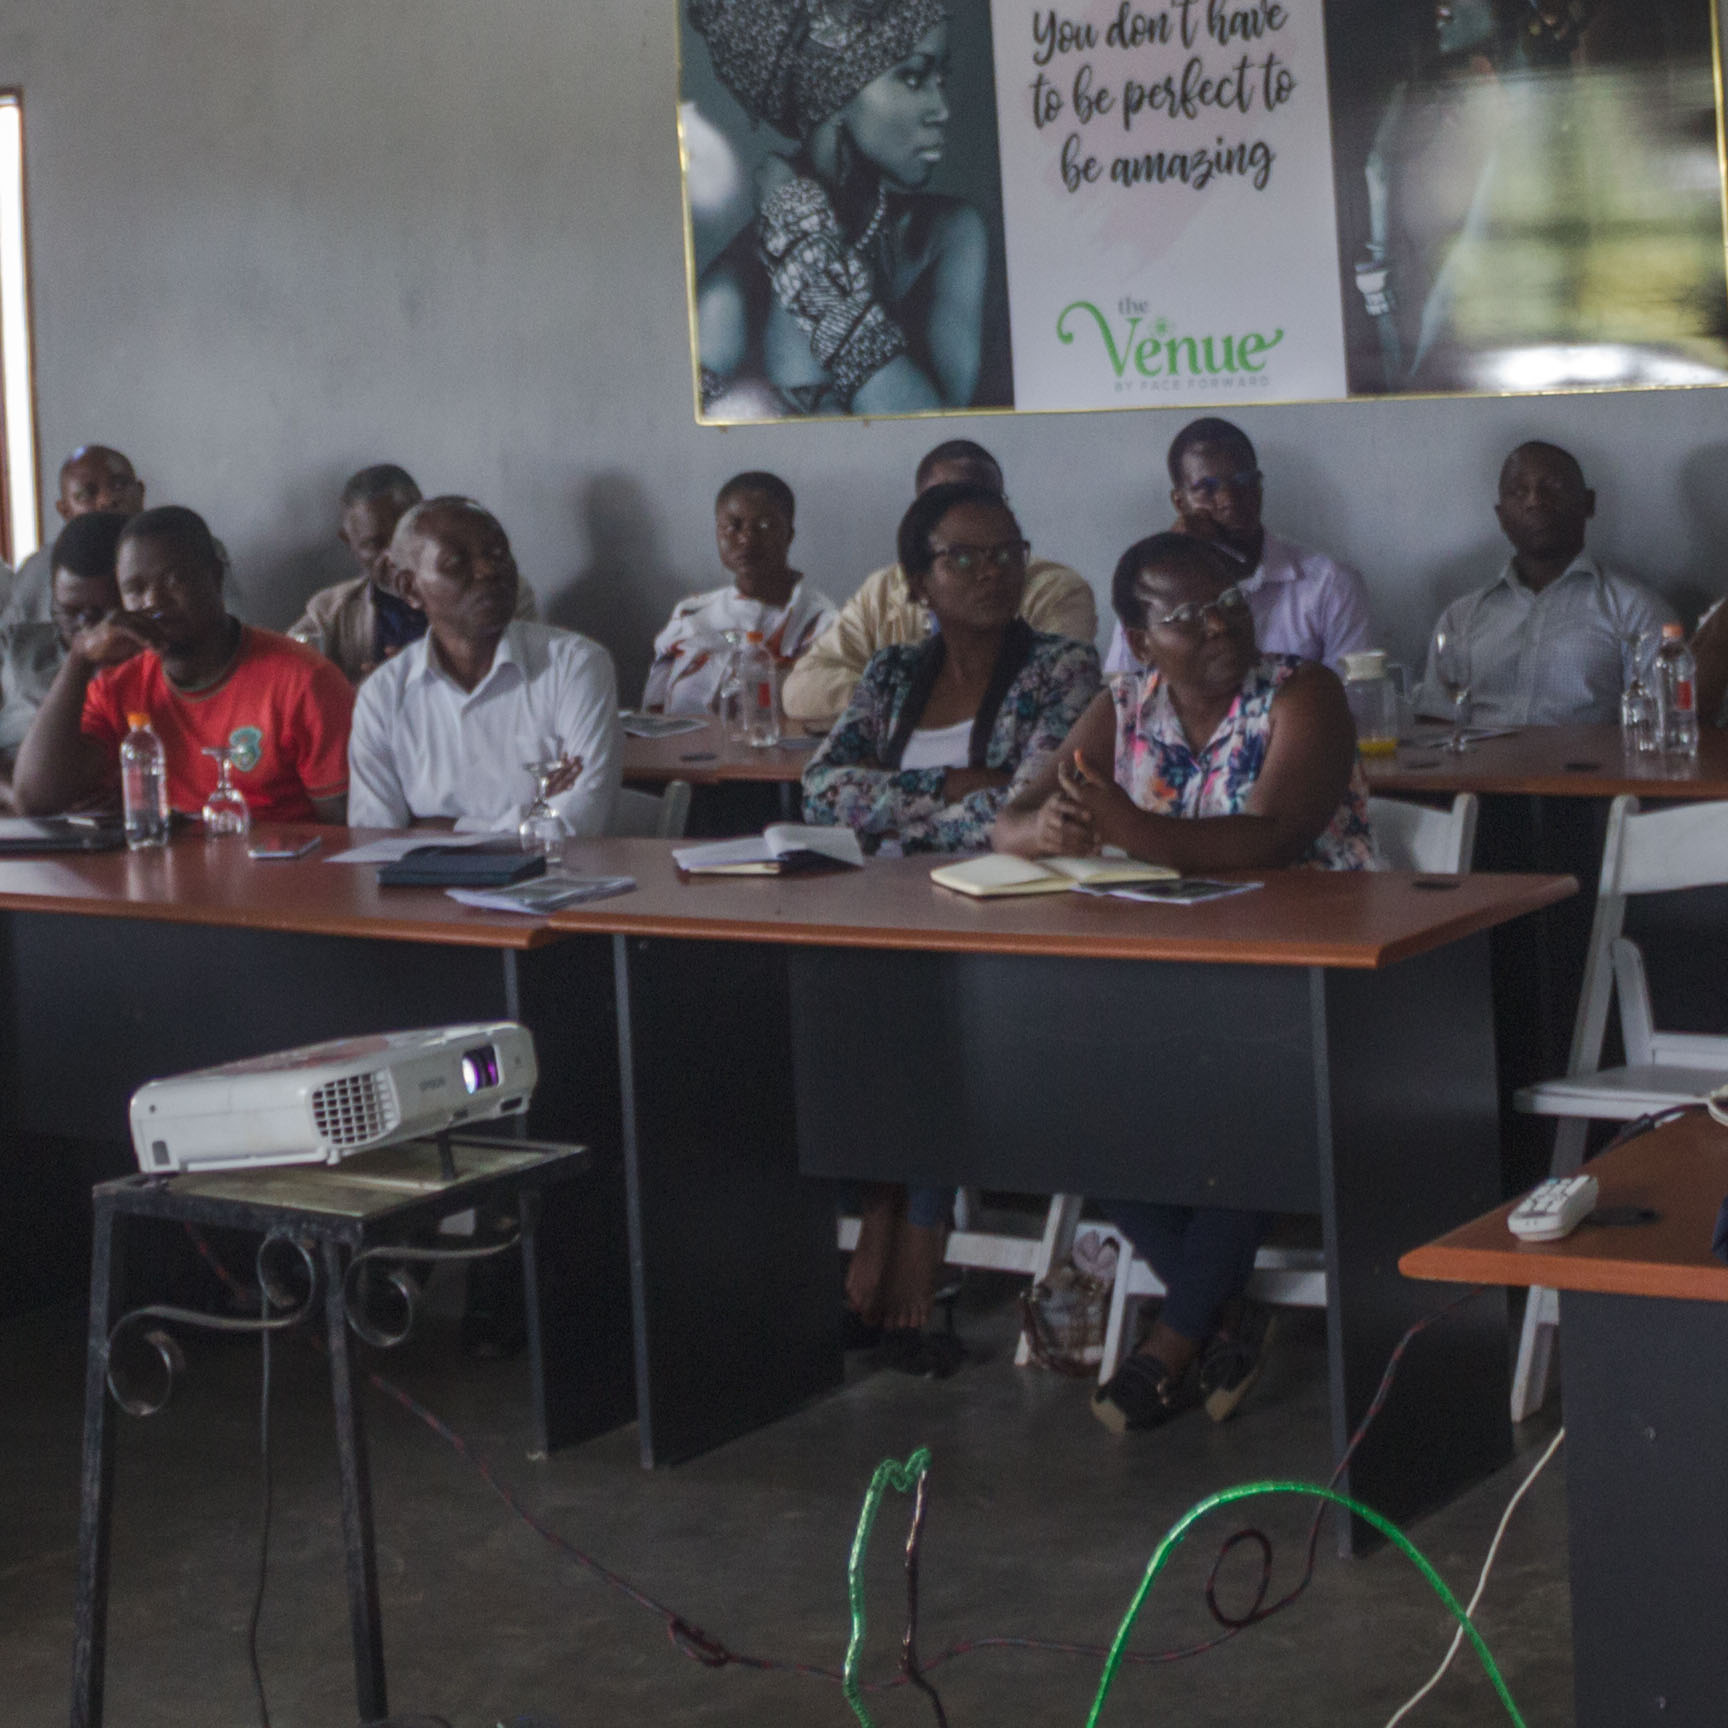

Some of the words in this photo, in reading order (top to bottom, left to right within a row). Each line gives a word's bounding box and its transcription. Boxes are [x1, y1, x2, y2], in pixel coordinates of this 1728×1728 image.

[1032, 9, 1099, 66] You
[1028, 72, 1064, 129] to
[1073, 64, 1115, 124] be
[1123, 55, 1255, 131] perfect
[1259, 51, 1297, 111] to
[1060, 132, 1103, 193] be
[1110, 136, 1276, 191] amazing
[1118, 296, 1150, 315] the
[1056, 300, 1285, 378] Venue
[1114, 380, 1133, 393] BY
[1187, 375, 1271, 389] FORWARD
